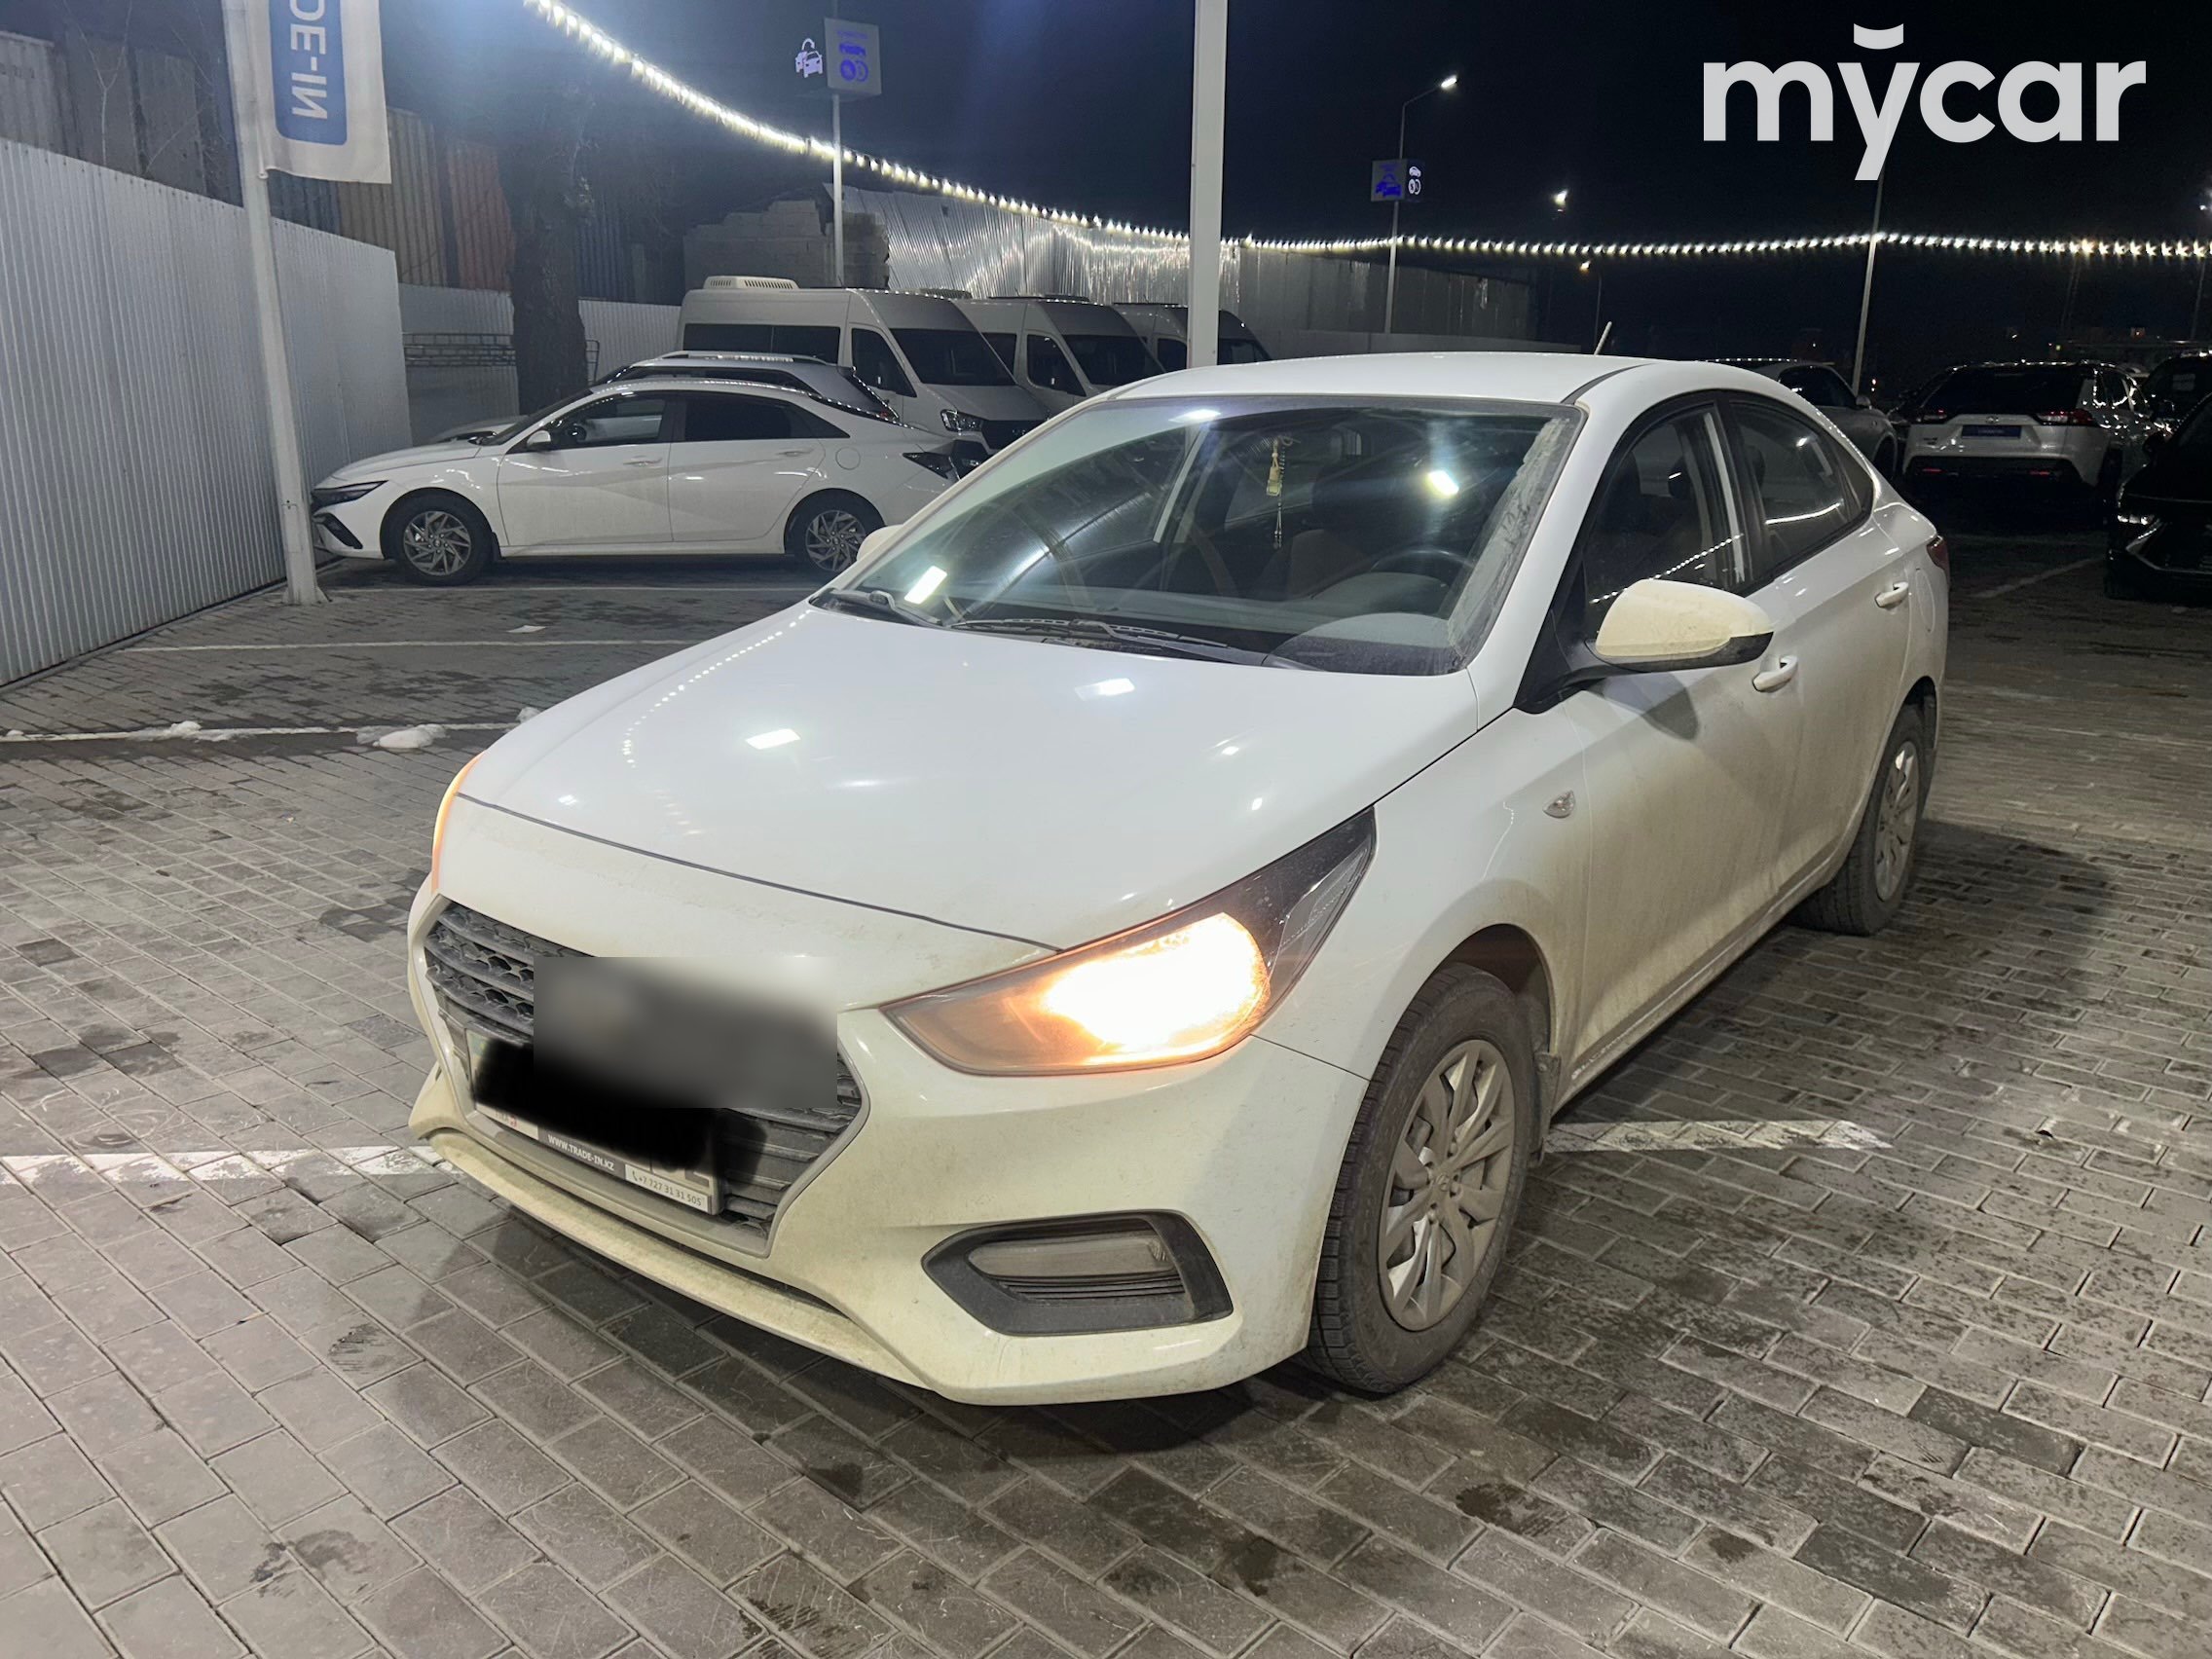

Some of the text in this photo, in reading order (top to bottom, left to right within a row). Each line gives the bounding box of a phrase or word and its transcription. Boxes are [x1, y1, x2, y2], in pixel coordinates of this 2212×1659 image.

[547, 1133, 615, 1171] WWW.TRADE-IN.KZ
[665, 1185, 674, 1196] 31
[676, 1189, 685, 1199] 31
